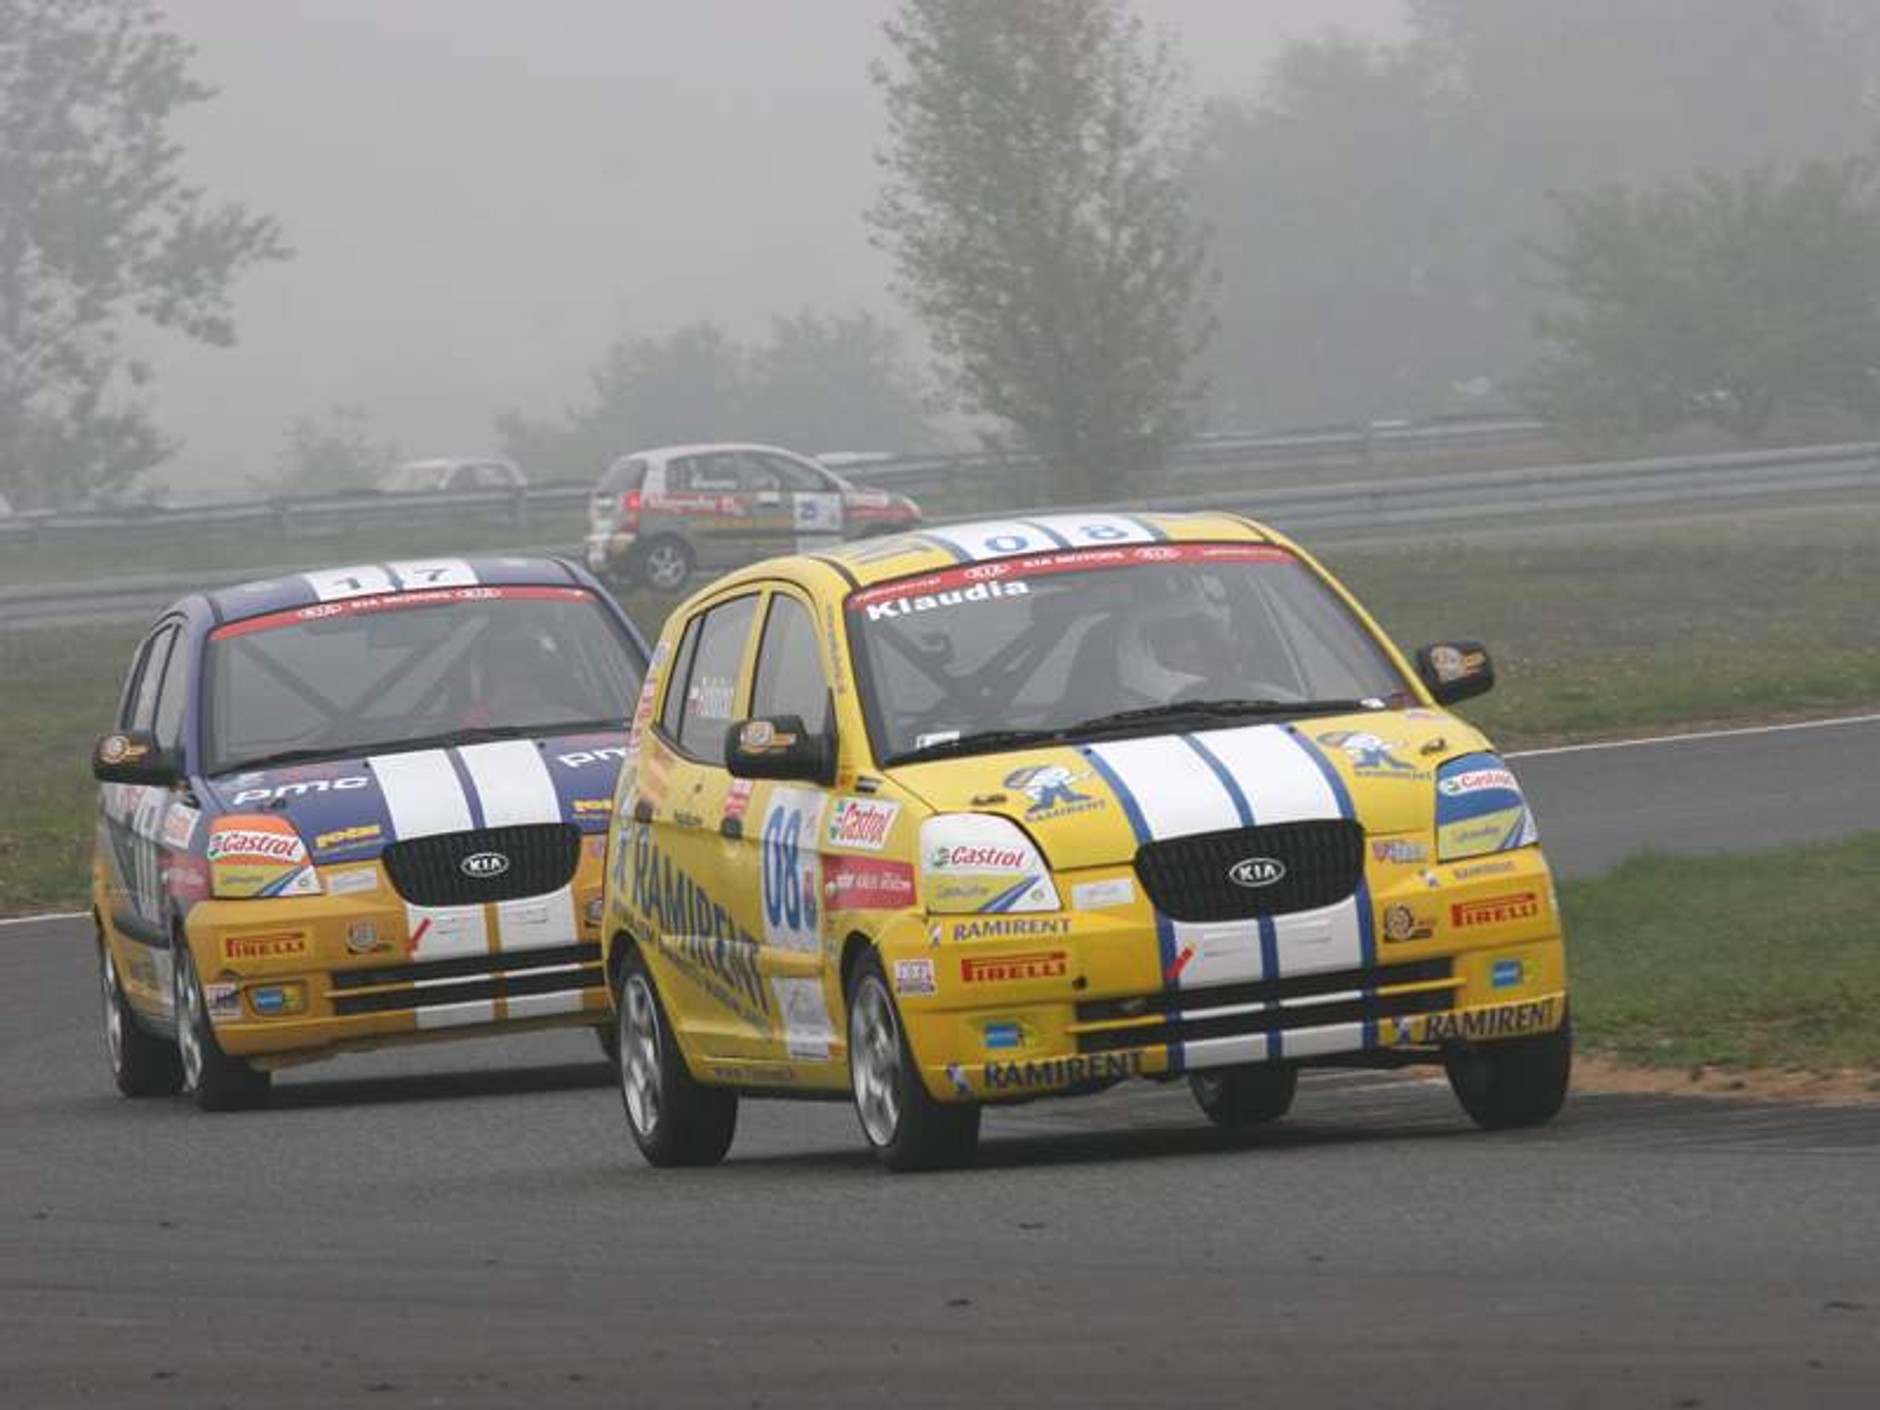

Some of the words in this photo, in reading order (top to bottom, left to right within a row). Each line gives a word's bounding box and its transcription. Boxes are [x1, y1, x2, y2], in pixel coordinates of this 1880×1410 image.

[866, 579, 1030, 621] Klaudia
[233, 776, 368, 805] pmc
[222, 833, 299, 858] Castrol
[950, 846, 1027, 868] Castrol
[764, 806, 802, 932] 08
[634, 828, 770, 1016] RAMIRENT
[1451, 893, 1538, 928] PIRELLI
[225, 931, 306, 958] PIRELLI
[953, 918, 1073, 942] RAMIRENT
[961, 951, 1067, 982] PIRELLI
[1424, 999, 1556, 1041] RAMIRENT
[983, 1050, 1142, 1089] RAMIRENT
